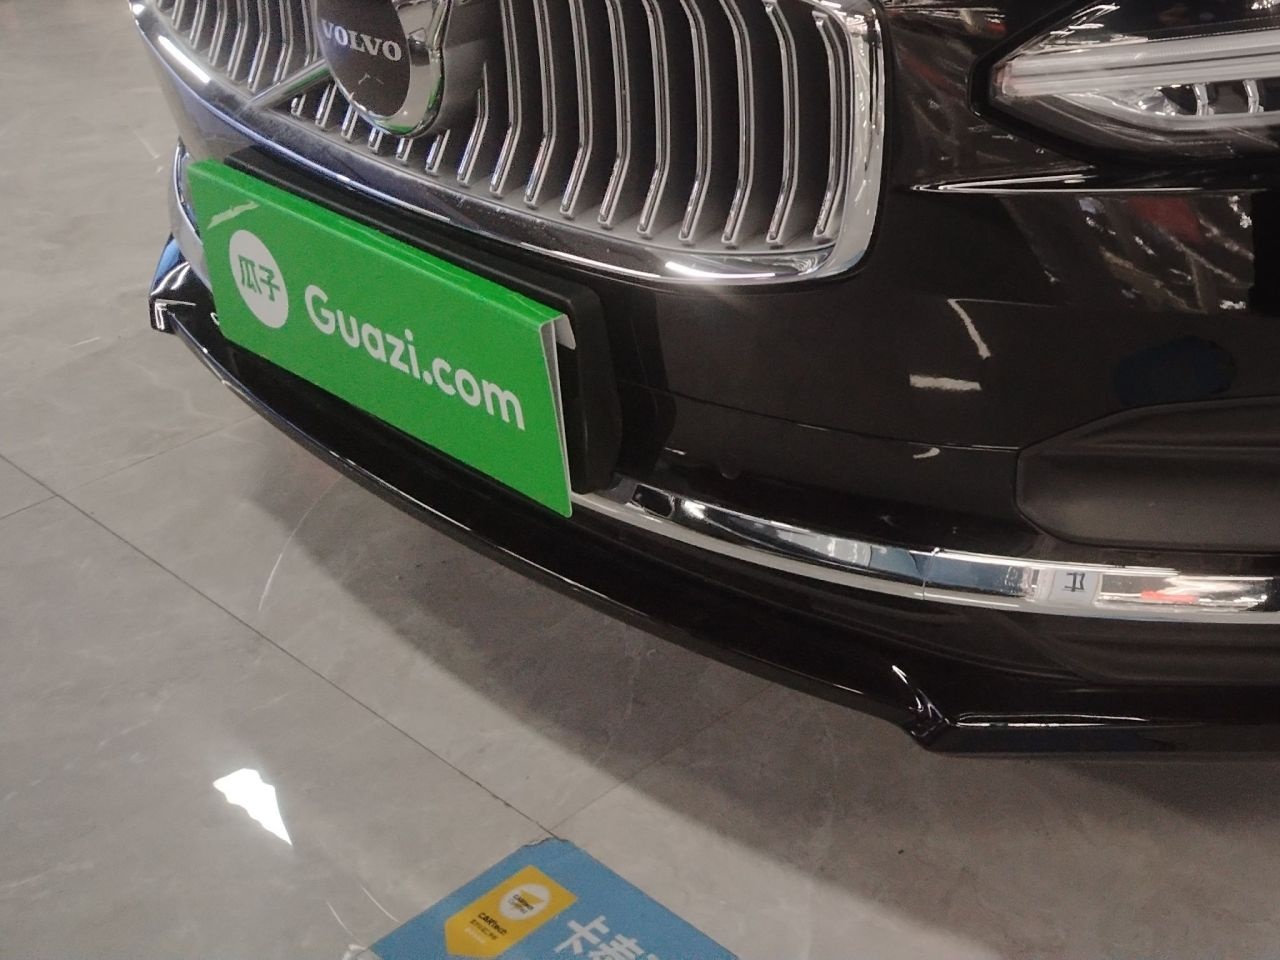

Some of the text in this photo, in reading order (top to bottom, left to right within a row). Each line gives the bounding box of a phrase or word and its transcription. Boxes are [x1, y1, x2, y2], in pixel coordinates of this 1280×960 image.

[320, 18, 403, 62] VOLVO
[237, 253, 281, 304] 瓜子
[304, 283, 526, 432] Guazi.com
